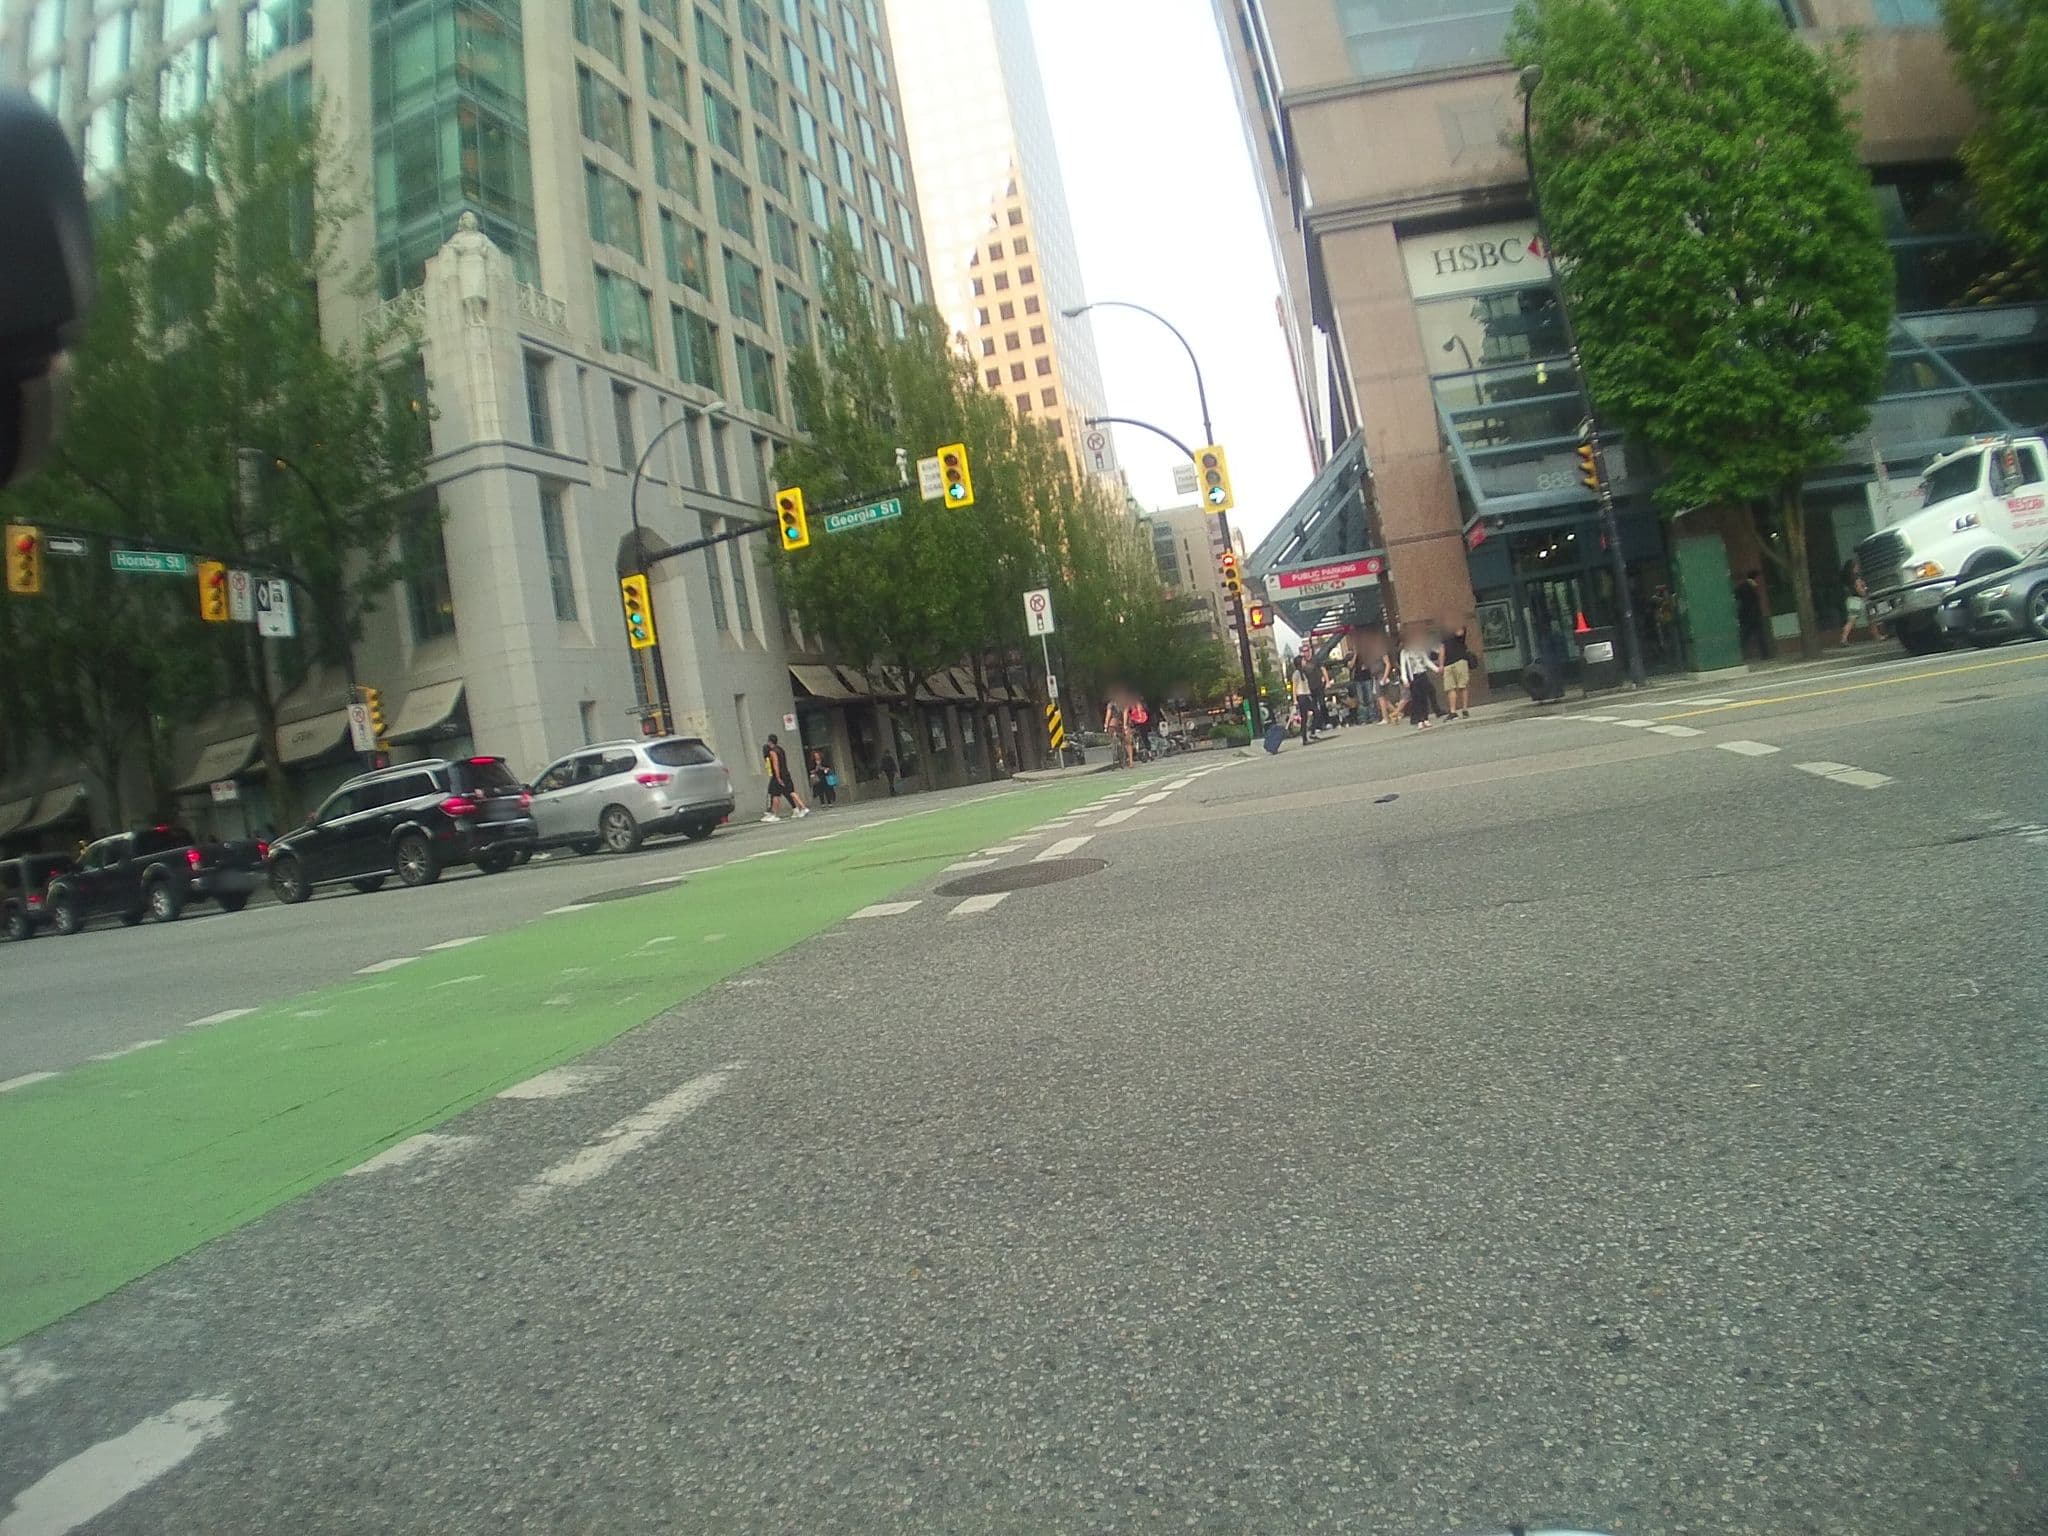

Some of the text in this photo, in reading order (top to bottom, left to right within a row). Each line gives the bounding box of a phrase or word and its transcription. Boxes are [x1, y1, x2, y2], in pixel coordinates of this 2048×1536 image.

[1432, 237, 1525, 275] HSBC
[831, 502, 895, 527] Georgia St
[116, 553, 180, 569] Hornby St
[1292, 570, 1320, 581] PUBLIC
[1321, 563, 1356, 577] PARKING
[1299, 580, 1329, 595] HSBC
